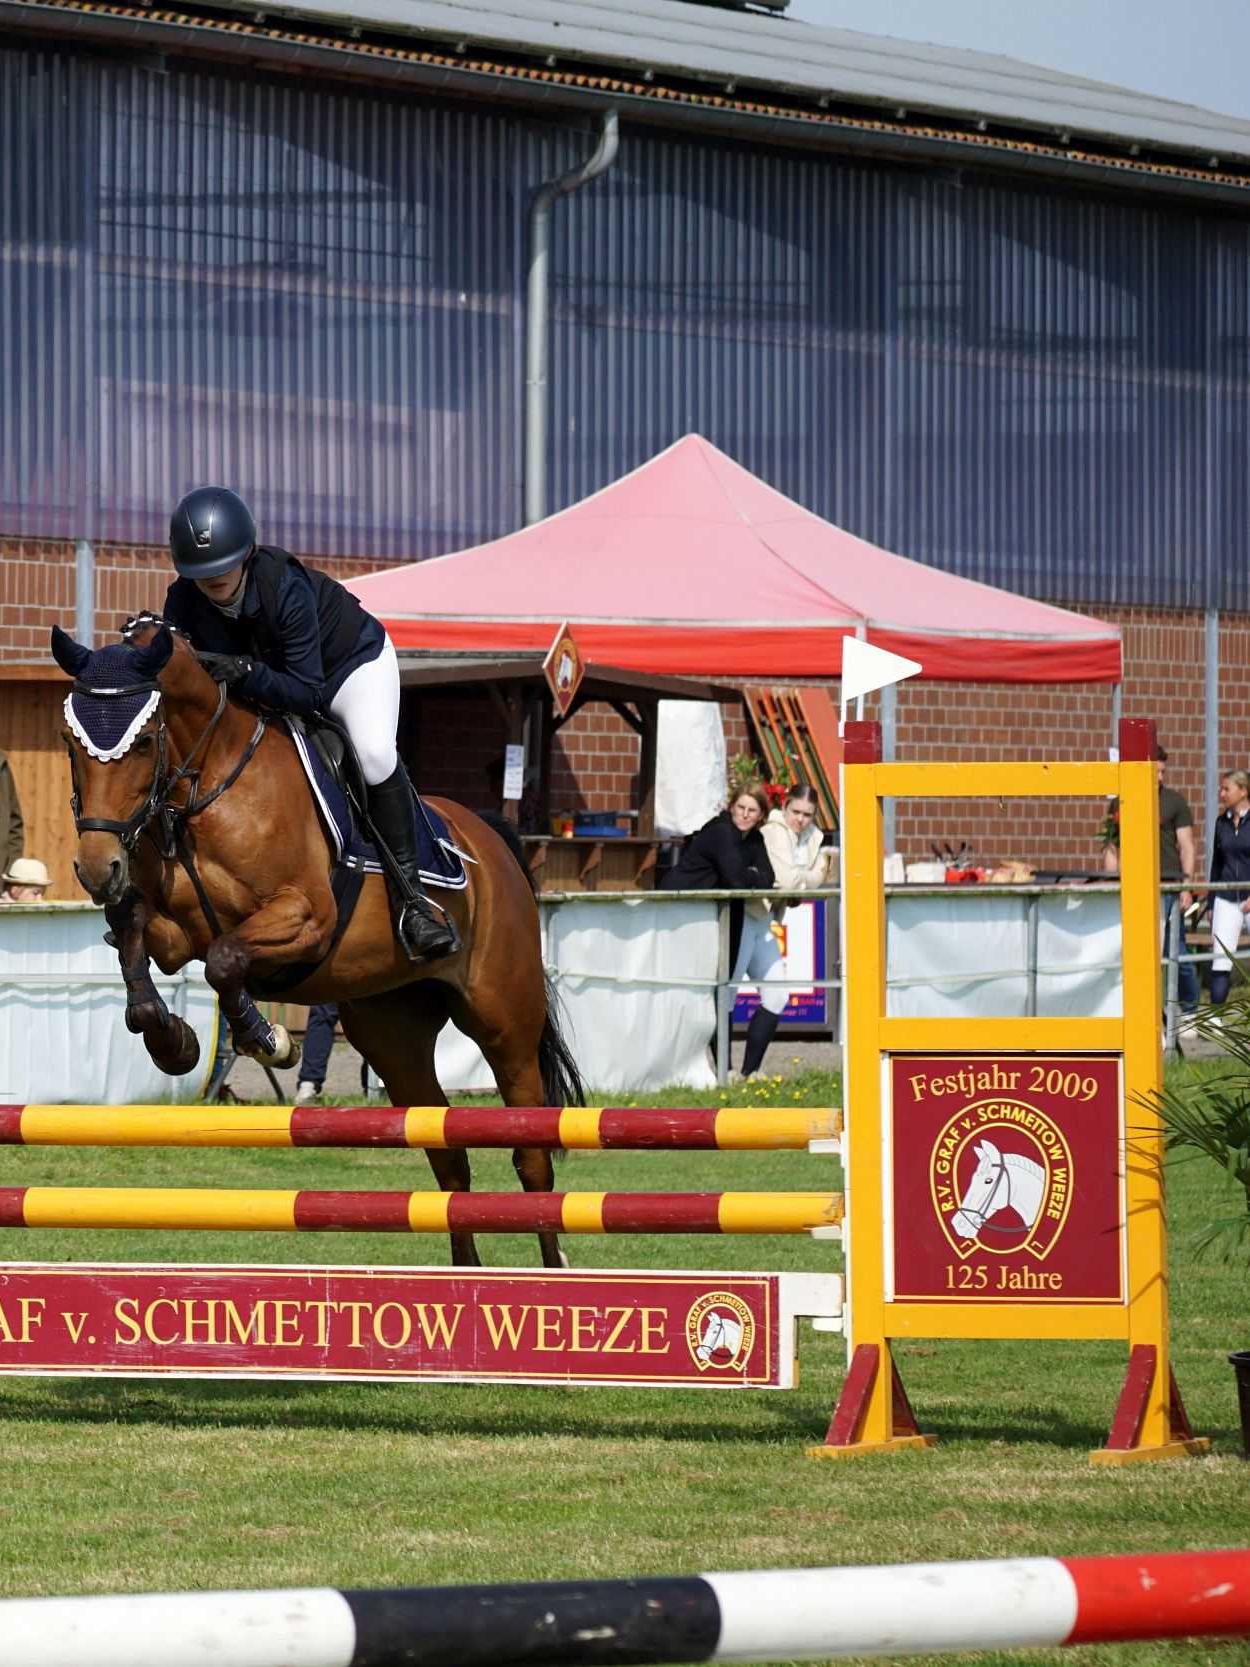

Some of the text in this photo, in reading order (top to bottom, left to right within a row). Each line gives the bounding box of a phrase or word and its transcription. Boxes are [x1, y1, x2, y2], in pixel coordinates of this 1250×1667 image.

[908, 1064, 1098, 1102] Festjahr 2009
[936, 1128, 961, 1174] GRAF
[977, 1105, 1064, 1160] SCHMETTOW
[1047, 1167, 1067, 1219] WEEZE
[945, 1265, 1062, 1290] 125 Jahre
[60, 1311, 97, 1345] v.
[114, 1297, 466, 1351] SCHMETTOW
[480, 1304, 670, 1354] WEEZE
